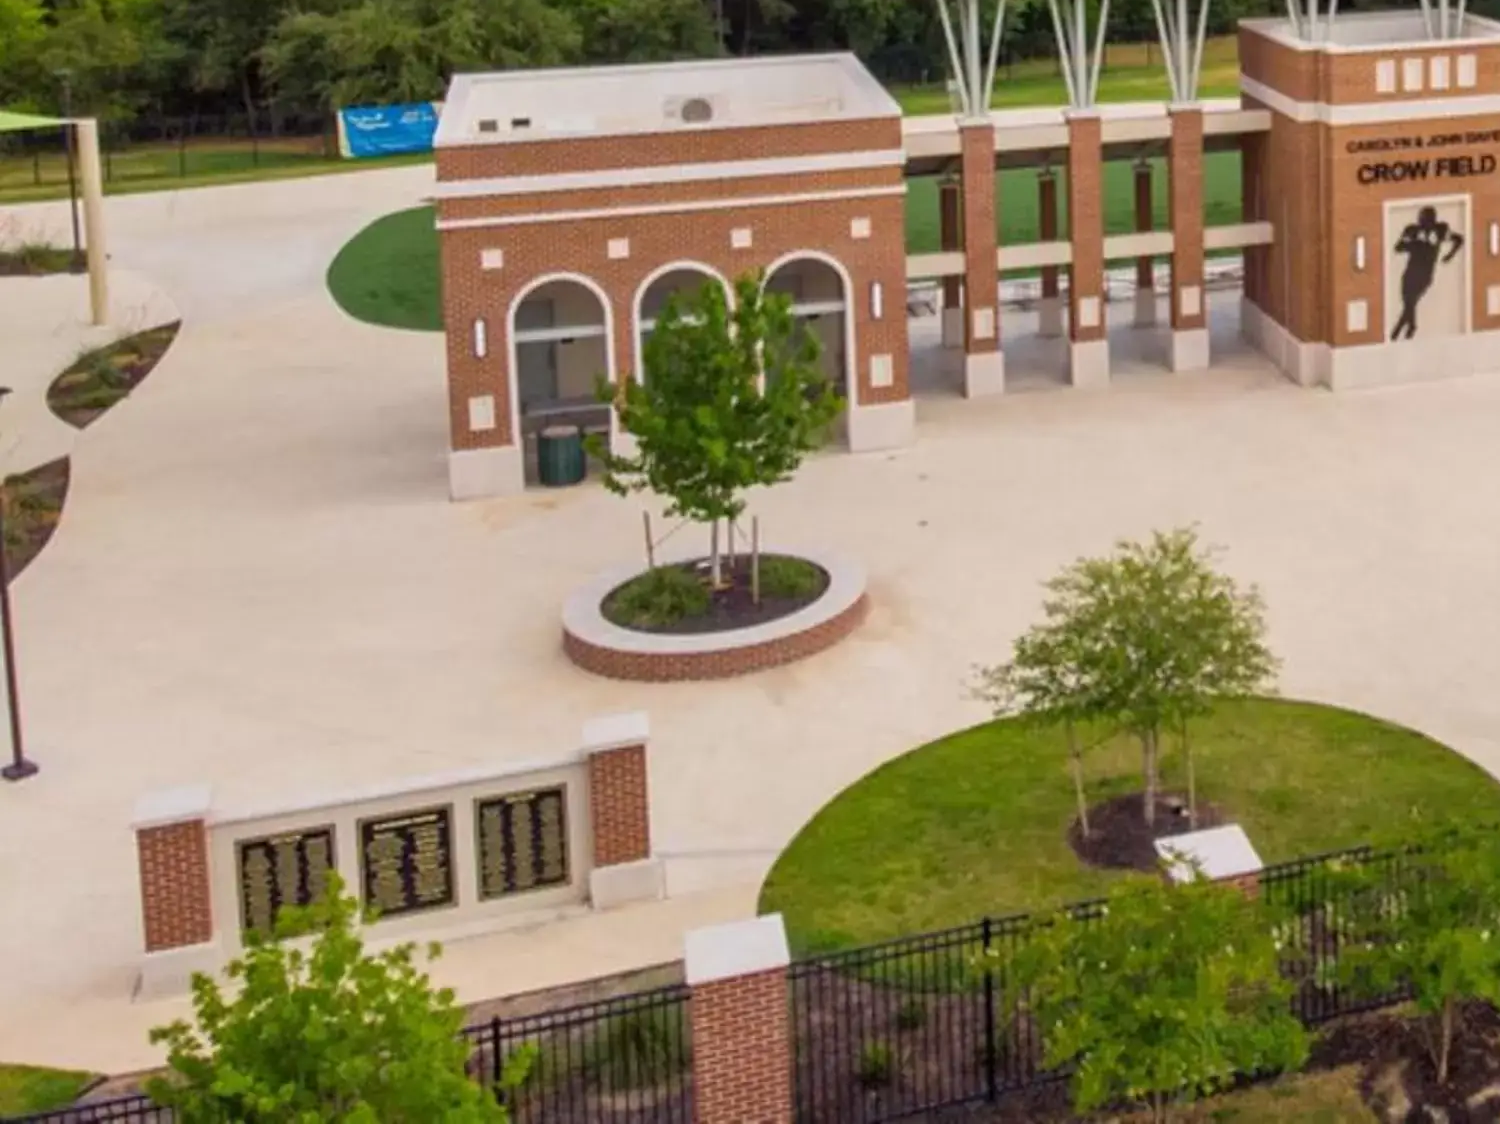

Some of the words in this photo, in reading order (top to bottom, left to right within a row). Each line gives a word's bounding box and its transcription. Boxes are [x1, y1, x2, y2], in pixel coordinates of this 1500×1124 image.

[1345, 137, 1412, 154] CAROLYN
[1415, 136, 1424, 148] &
[1427, 133, 1463, 147] JOHN
[1356, 158, 1430, 185] CROW
[1435, 154, 1498, 177] FIELD
